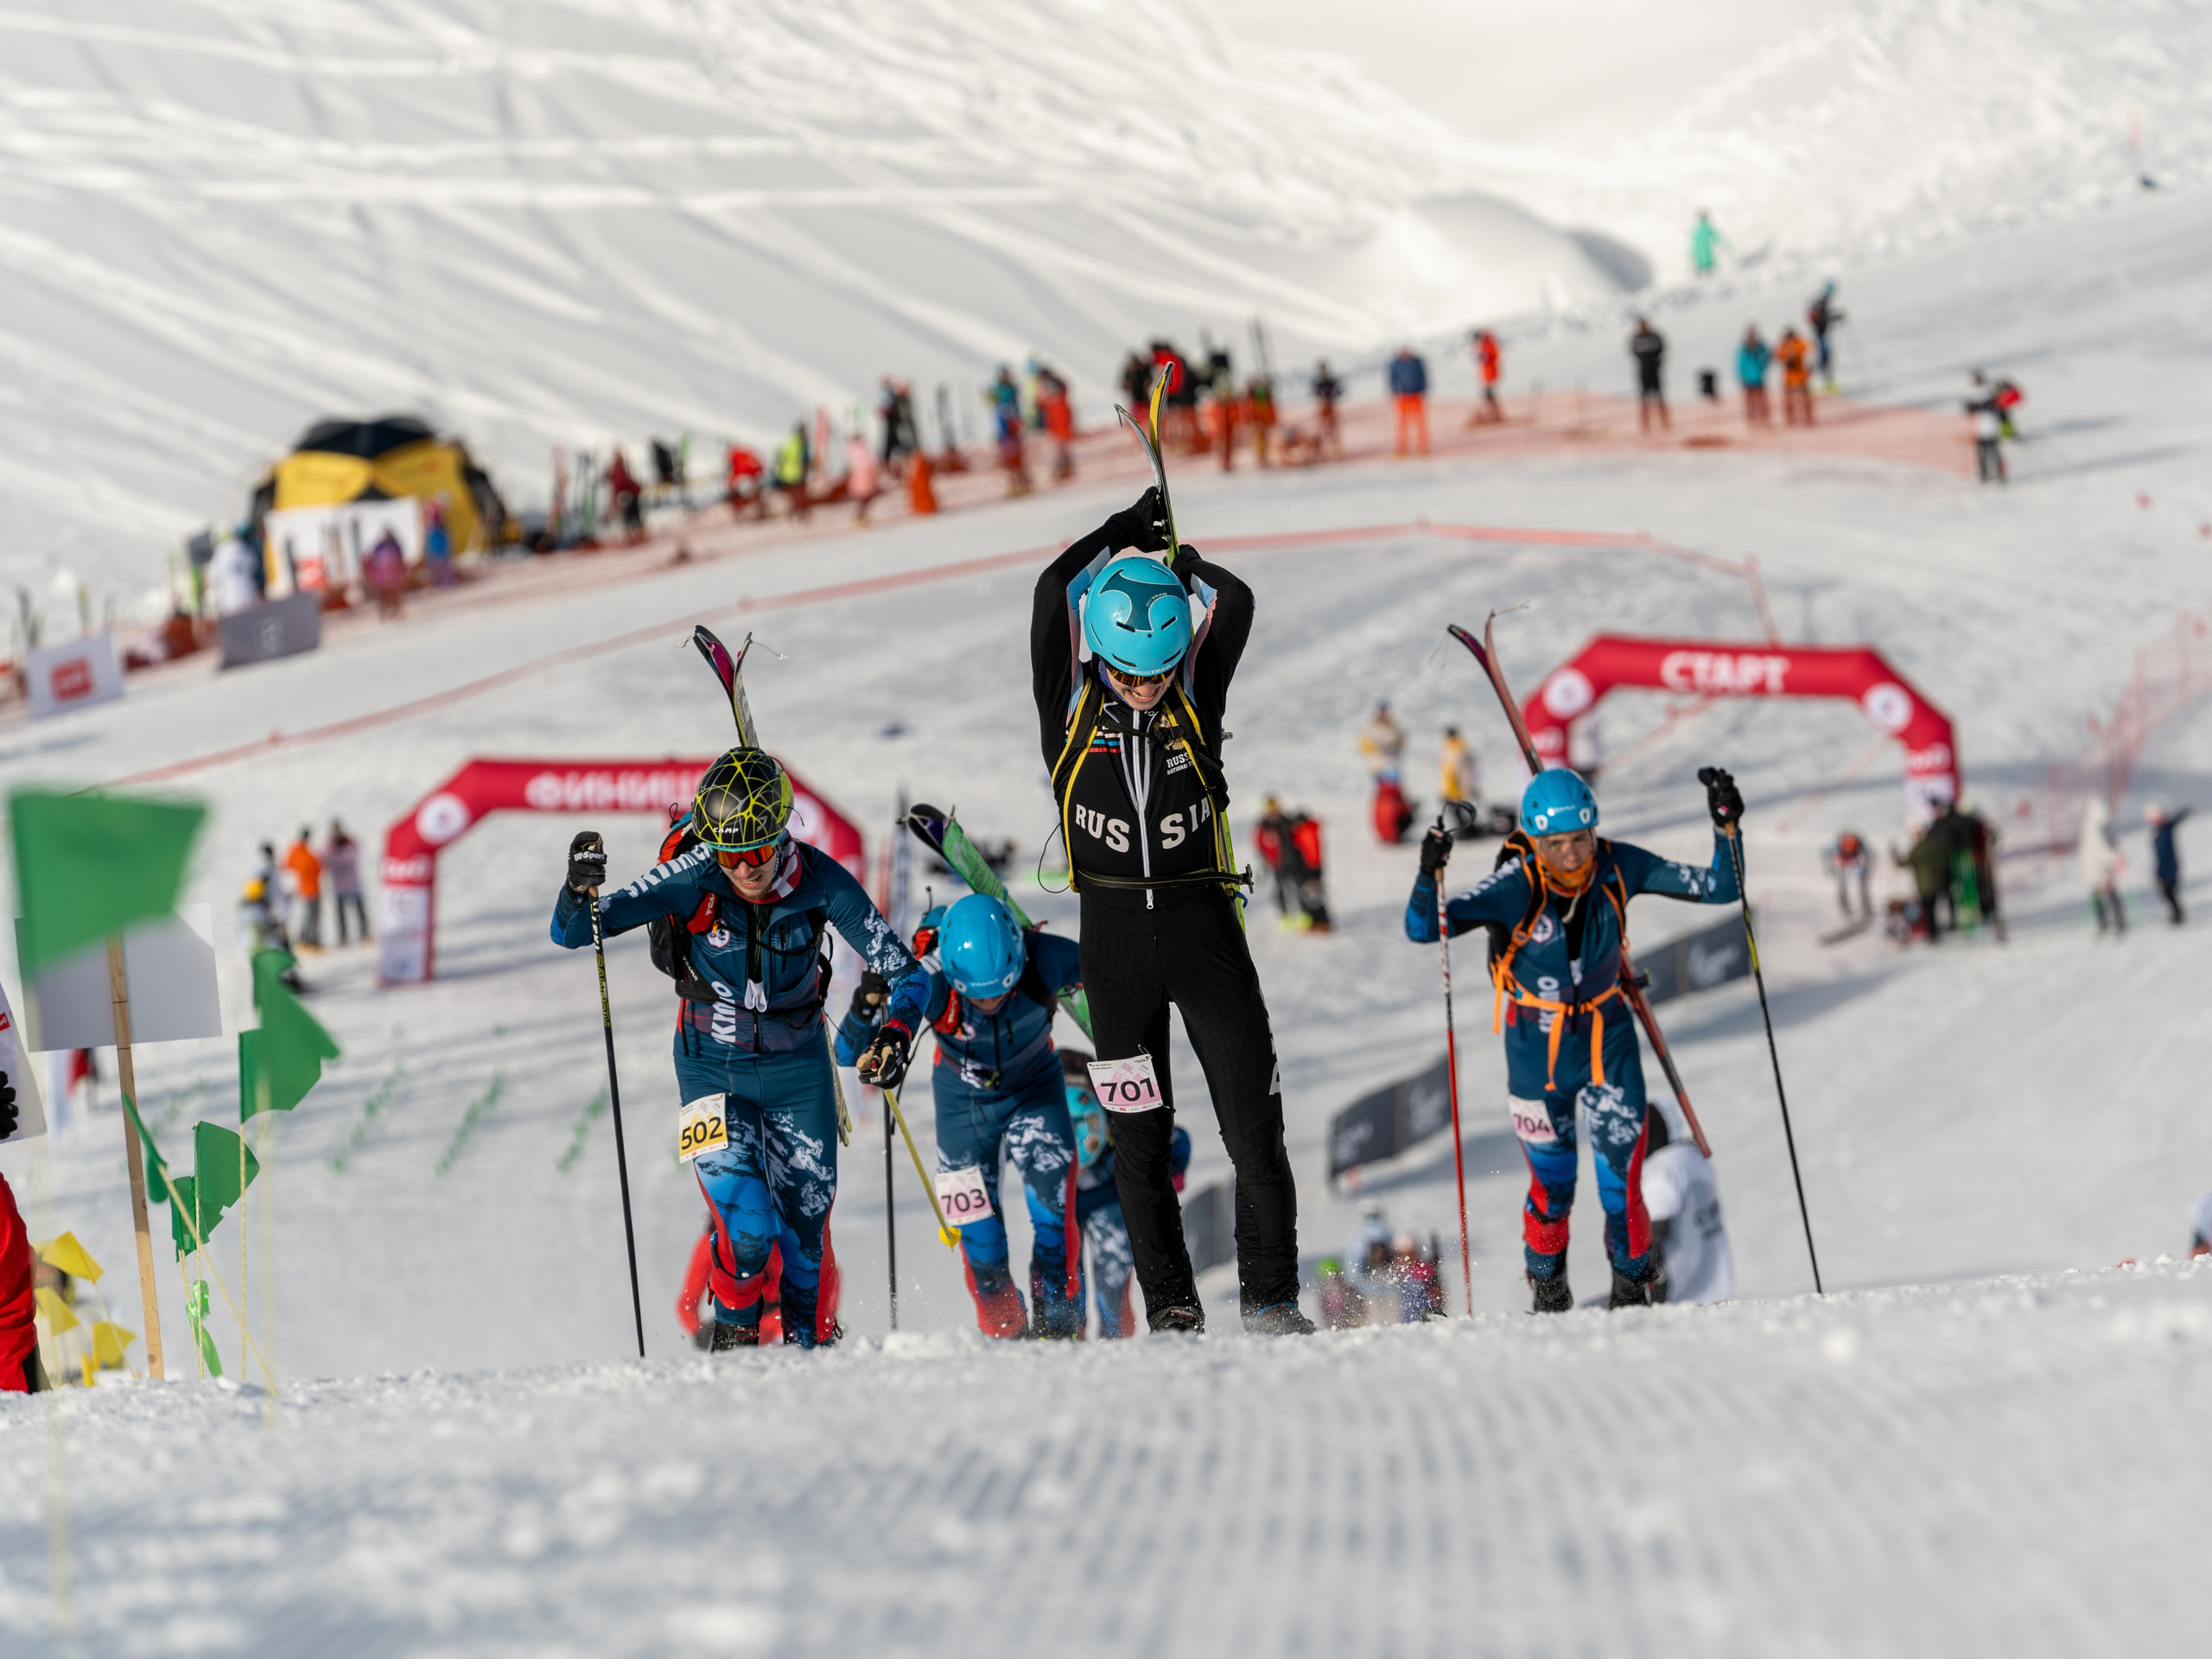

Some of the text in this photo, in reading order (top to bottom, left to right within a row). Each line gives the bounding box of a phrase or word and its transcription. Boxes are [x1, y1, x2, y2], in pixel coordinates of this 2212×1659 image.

[1660, 650, 1791, 692] СТАРТ
[1166, 752, 1191, 768] RUSS
[1101, 1077, 1154, 1102] 701
[681, 1116, 723, 1150] 502
[1514, 1113, 1550, 1134] 704
[941, 1189, 986, 1215] 703
